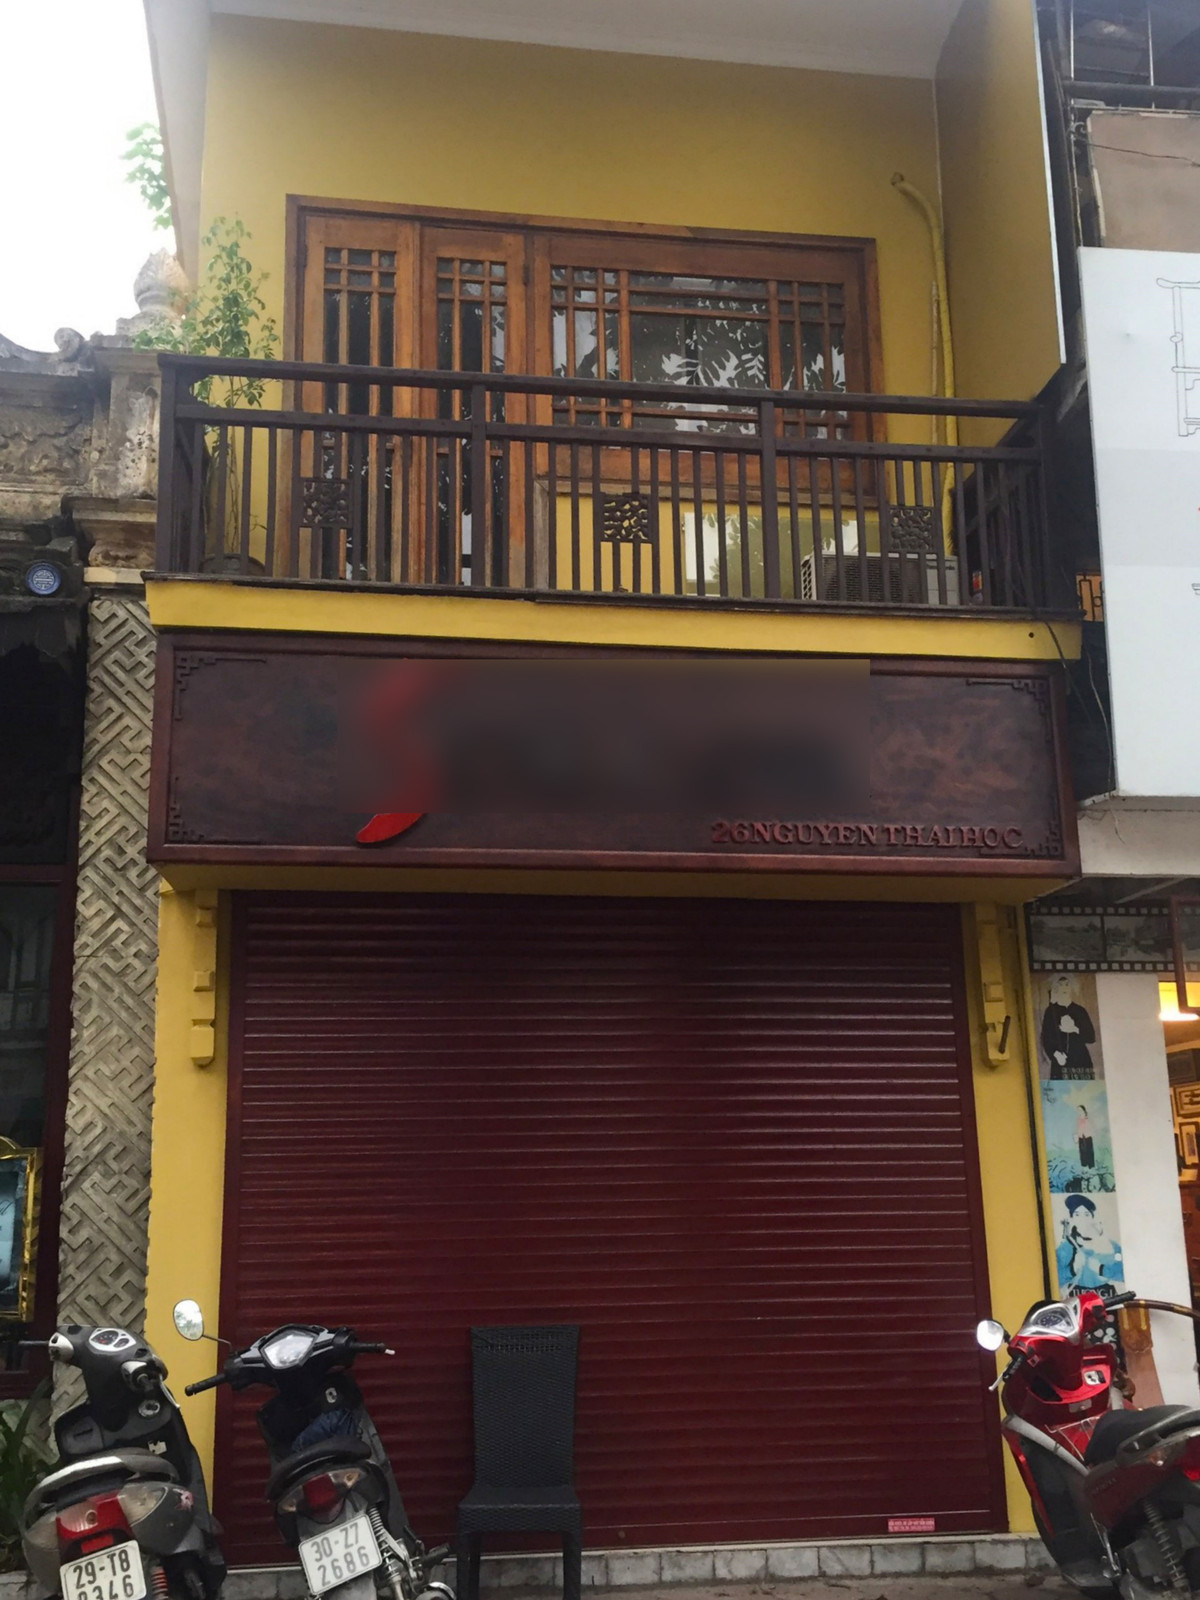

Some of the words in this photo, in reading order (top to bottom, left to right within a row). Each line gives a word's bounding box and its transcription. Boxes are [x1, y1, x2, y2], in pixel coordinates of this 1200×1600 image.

[311, 1522, 359, 1562] 30-Z7
[73, 1549, 130, 1590] 29-T8
[318, 1546, 370, 1587] 2686
